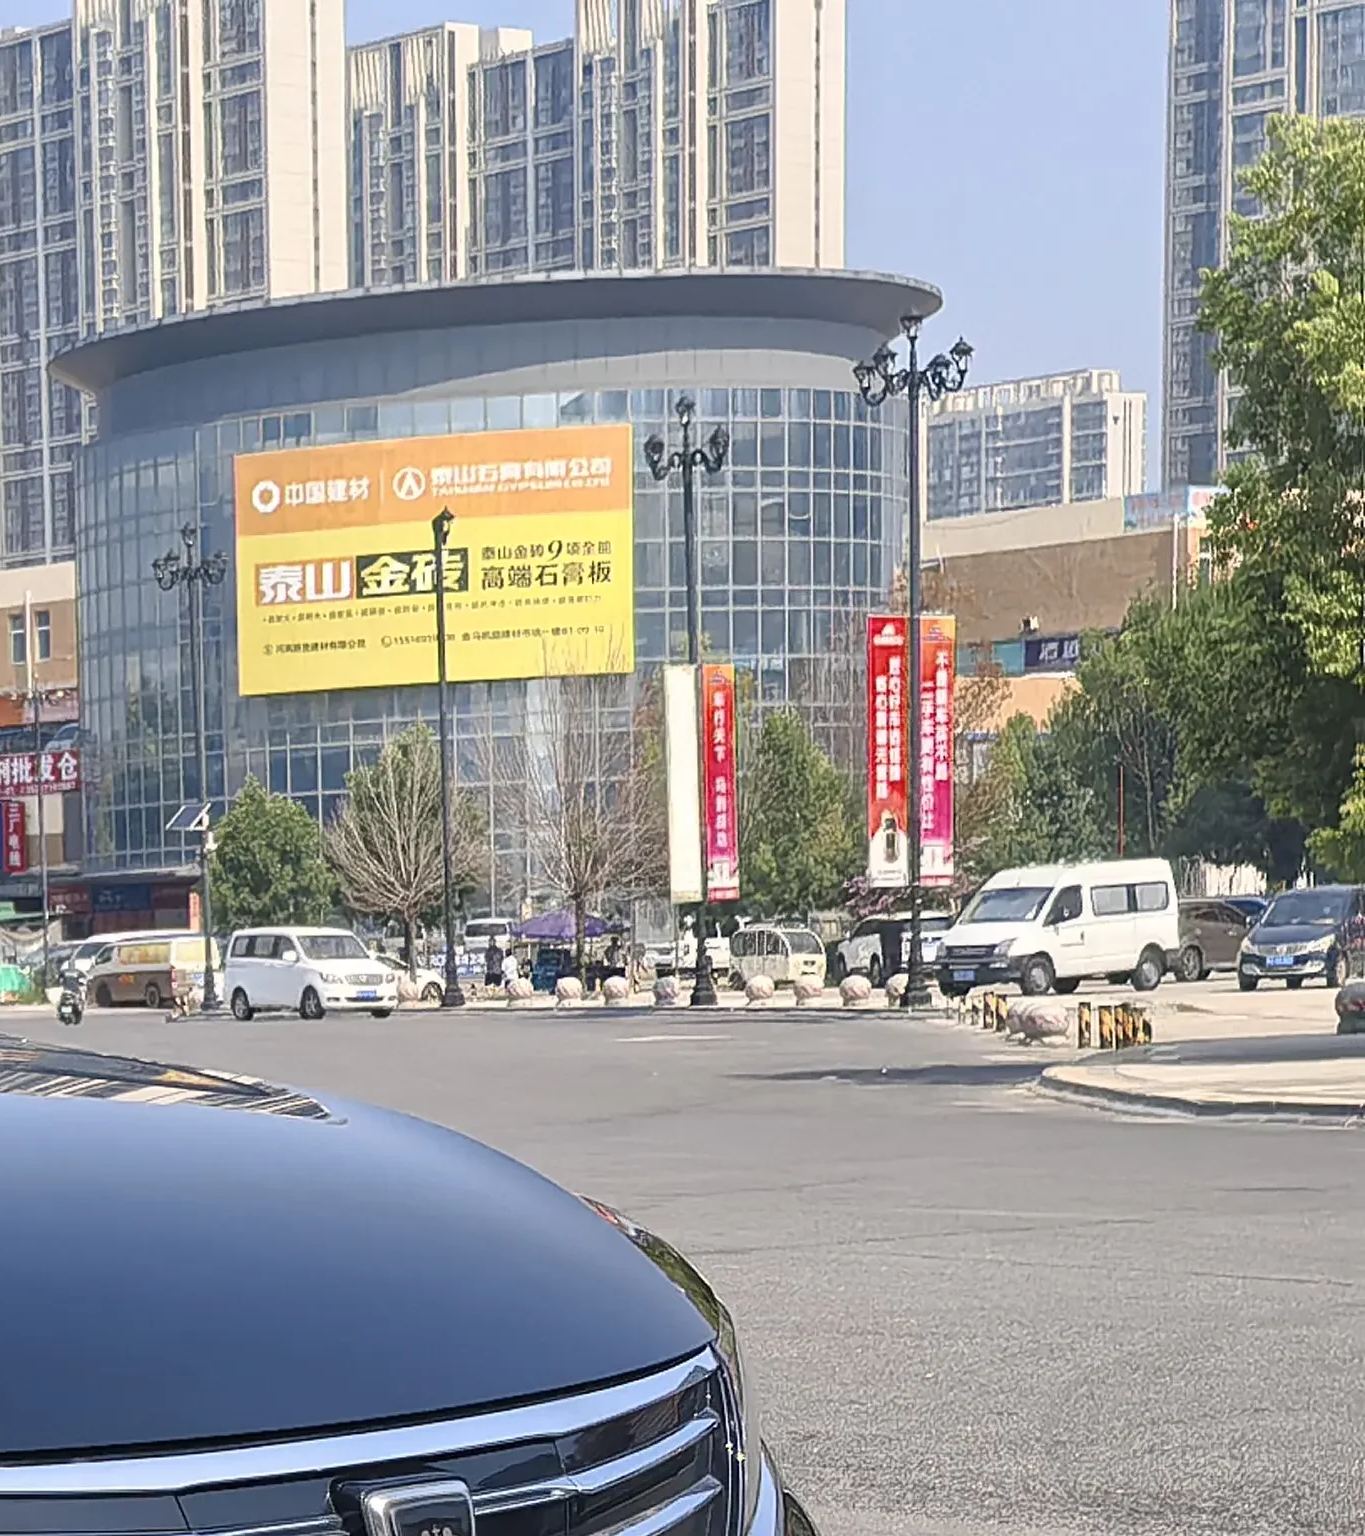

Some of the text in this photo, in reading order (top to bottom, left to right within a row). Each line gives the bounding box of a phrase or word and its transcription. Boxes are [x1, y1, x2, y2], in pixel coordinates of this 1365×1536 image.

[284, 477, 369, 507] 中国建材
[259, 551, 464, 605] 泰山金砖
[480, 560, 612, 591] 高端石膏板
